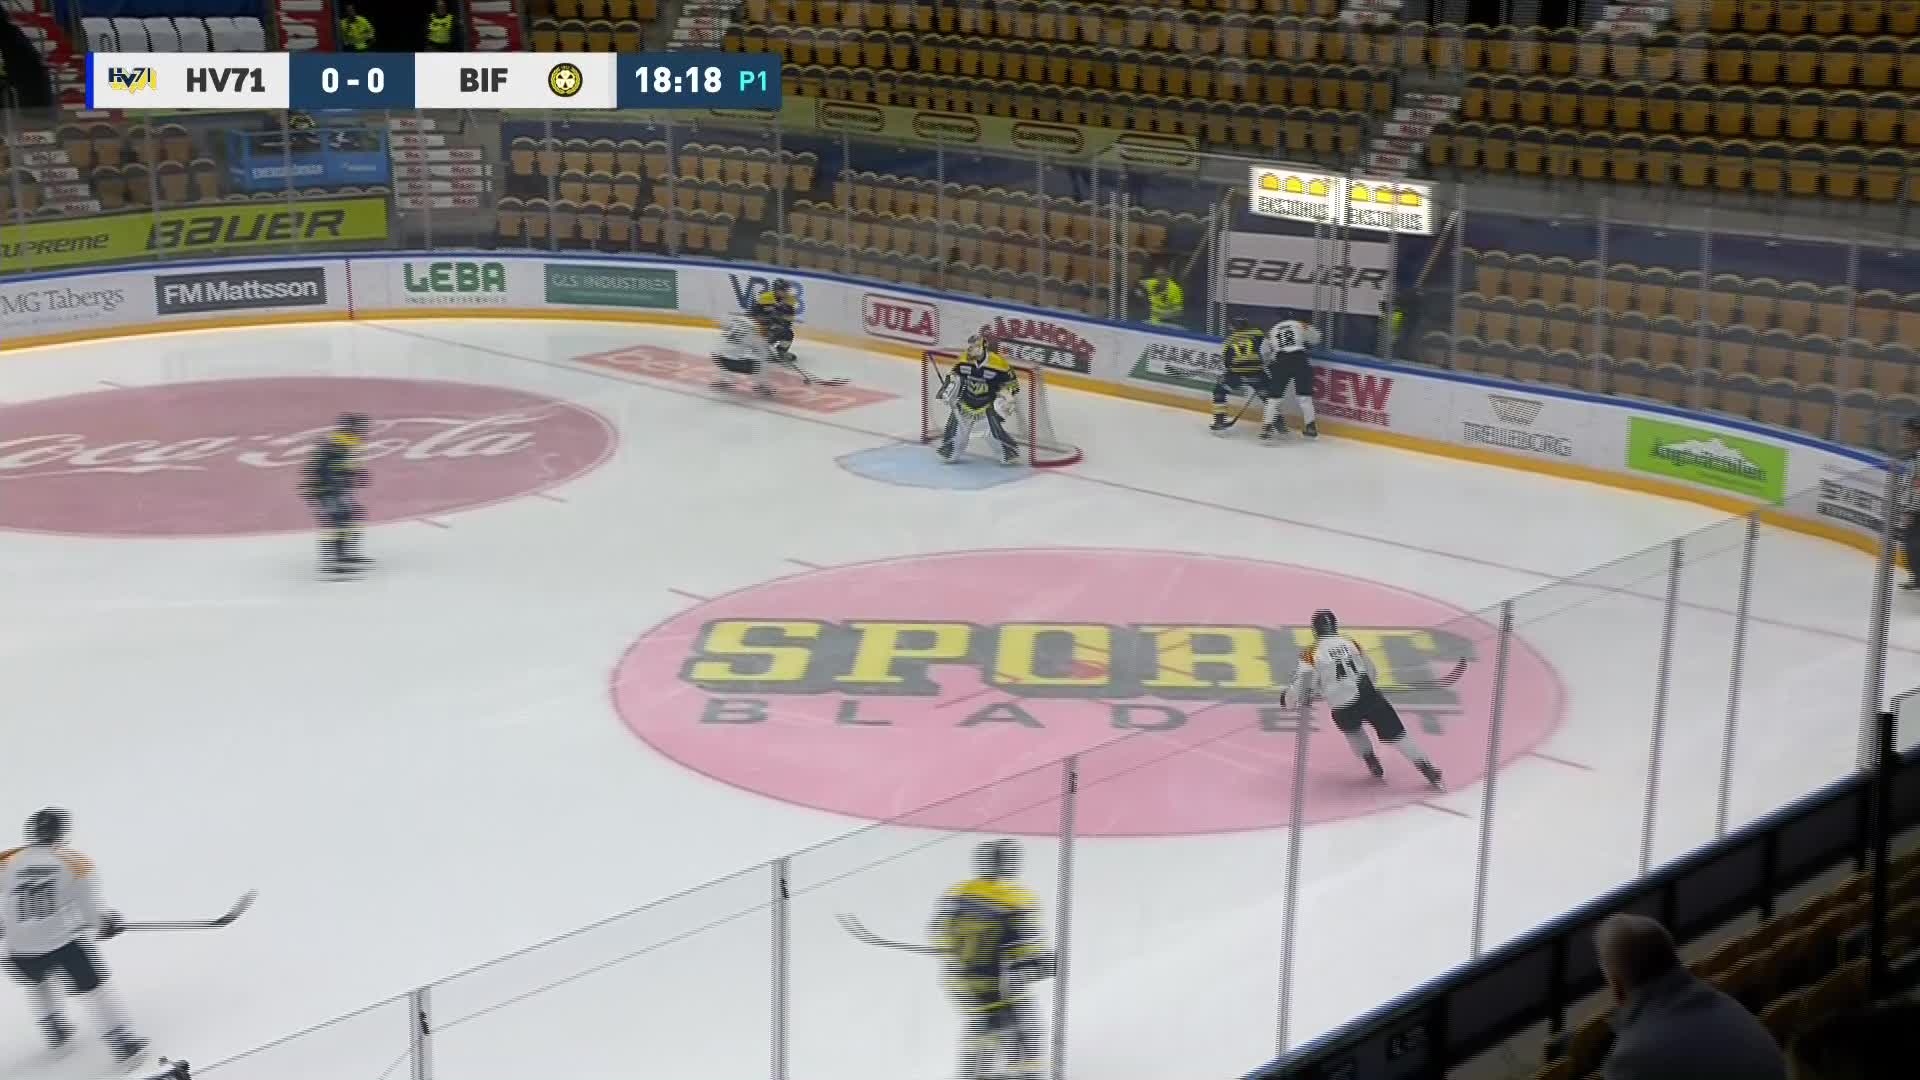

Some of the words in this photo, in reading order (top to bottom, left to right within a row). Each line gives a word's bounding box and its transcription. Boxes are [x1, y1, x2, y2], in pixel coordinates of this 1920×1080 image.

[145, 208, 347, 251] BAUER
[0, 231, 109, 261] UPREME
[403, 262, 507, 292] LEBA
[583, 274, 672, 292] INDUSTRIES
[1225, 256, 1390, 290] BAUER
[43, 288, 126, 312] Tabergs
[163, 282, 203, 305] FM
[206, 277, 319, 303] Mattsson
[865, 301, 935, 337] JULA
[1275, 330, 1297, 349] 18
[1048, 350, 1076, 368] AB
[1150, 343, 1225, 372] HAKAR
[1311, 365, 1395, 412] SEW
[1311, 403, 1392, 427] URODRIVE
[1461, 421, 1573, 457] TRELLEBORG
[686, 618, 1450, 697] SPORT
[1335, 656, 1360, 682] 41
[697, 697, 1465, 738] BLADET
[10, 882, 57, 923] 11
